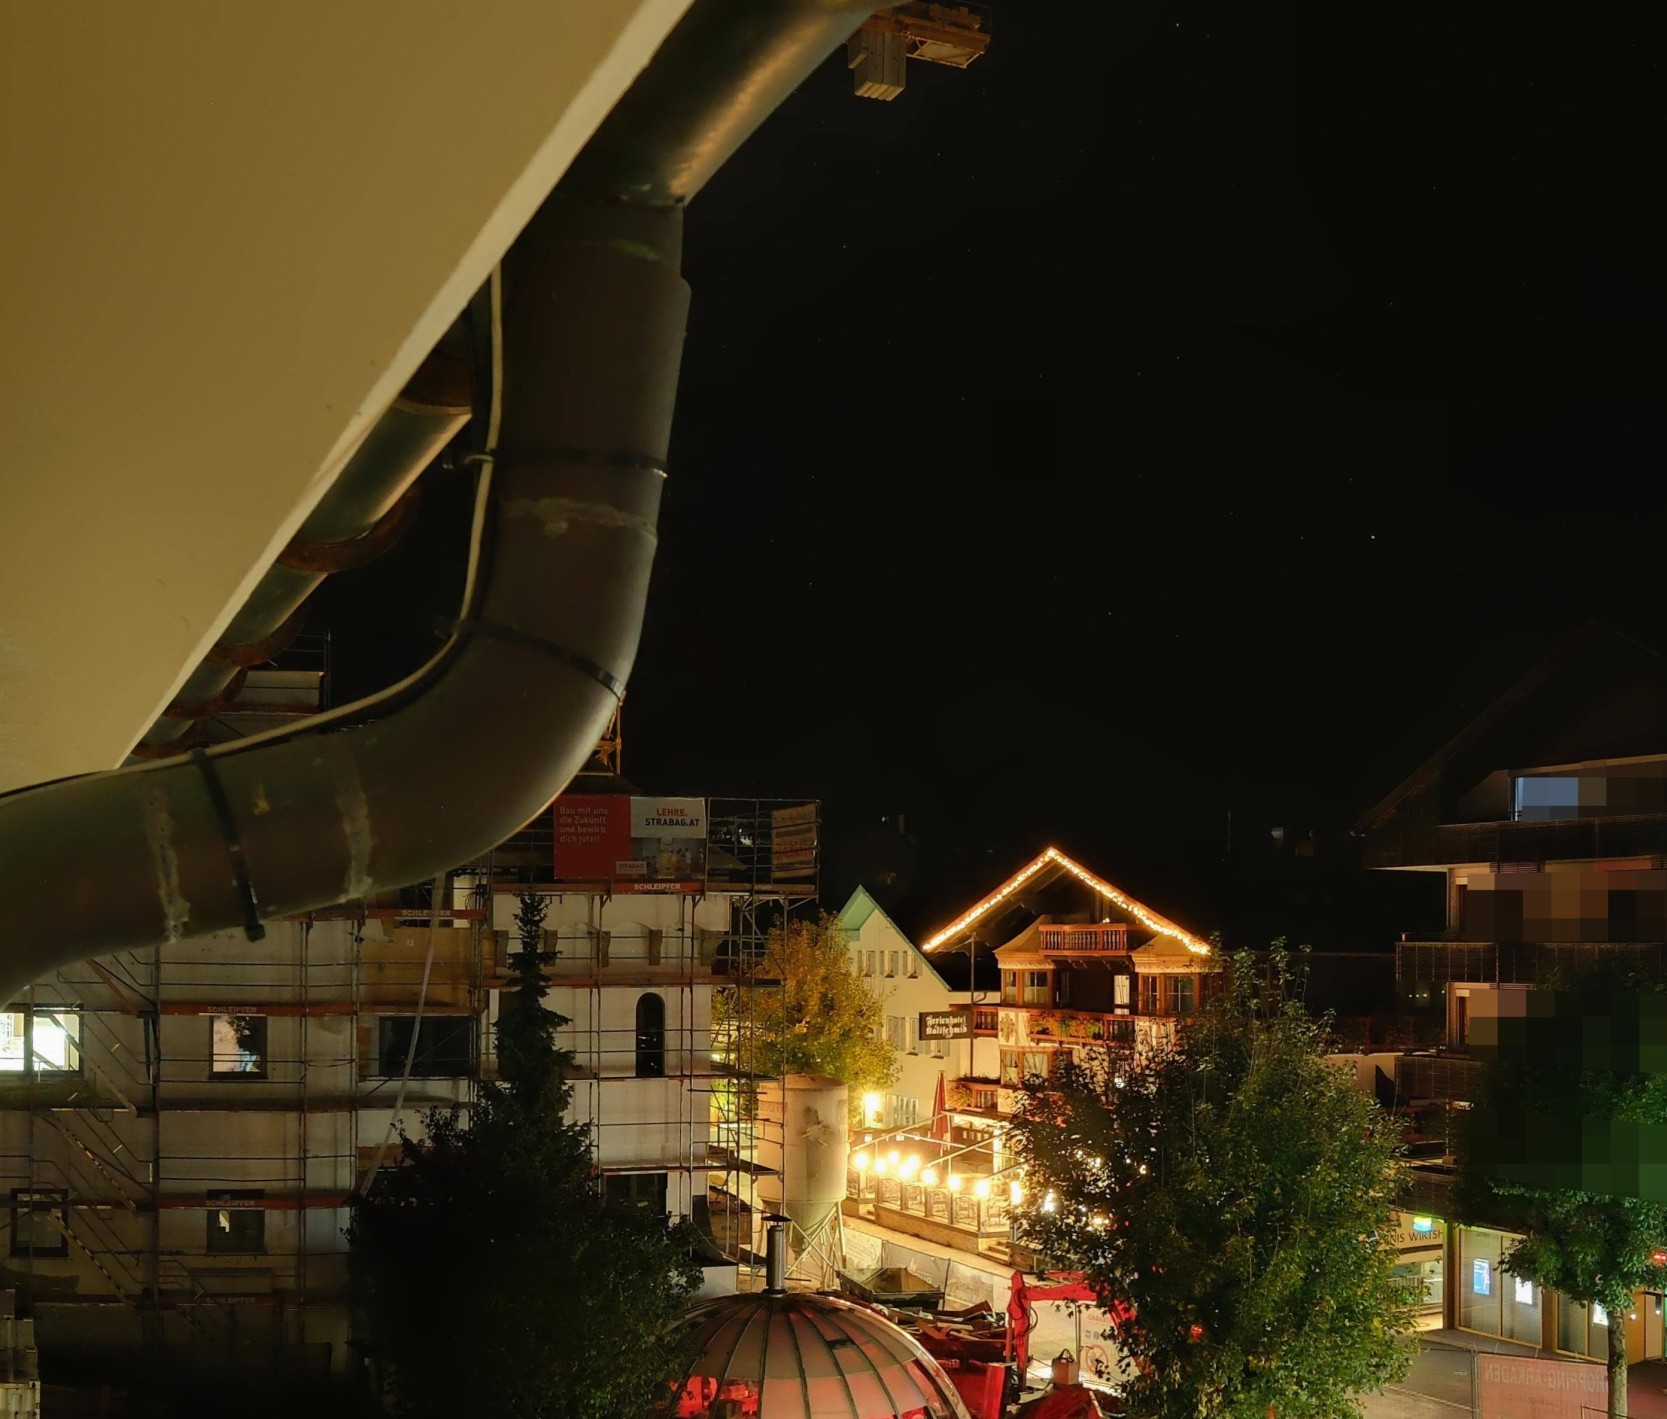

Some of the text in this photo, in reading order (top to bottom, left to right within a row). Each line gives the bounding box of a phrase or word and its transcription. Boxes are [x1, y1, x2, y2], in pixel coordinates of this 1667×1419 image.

[560, 806, 608, 815] Bau mit uns
[656, 807, 688, 817] LEHRE.
[560, 816, 606, 825] die Zukunft
[645, 818, 700, 828] STRABAG.AT
[634, 883, 681, 891] SCHLEIPFER
[401, 909, 451, 917] SCHLEPFER
